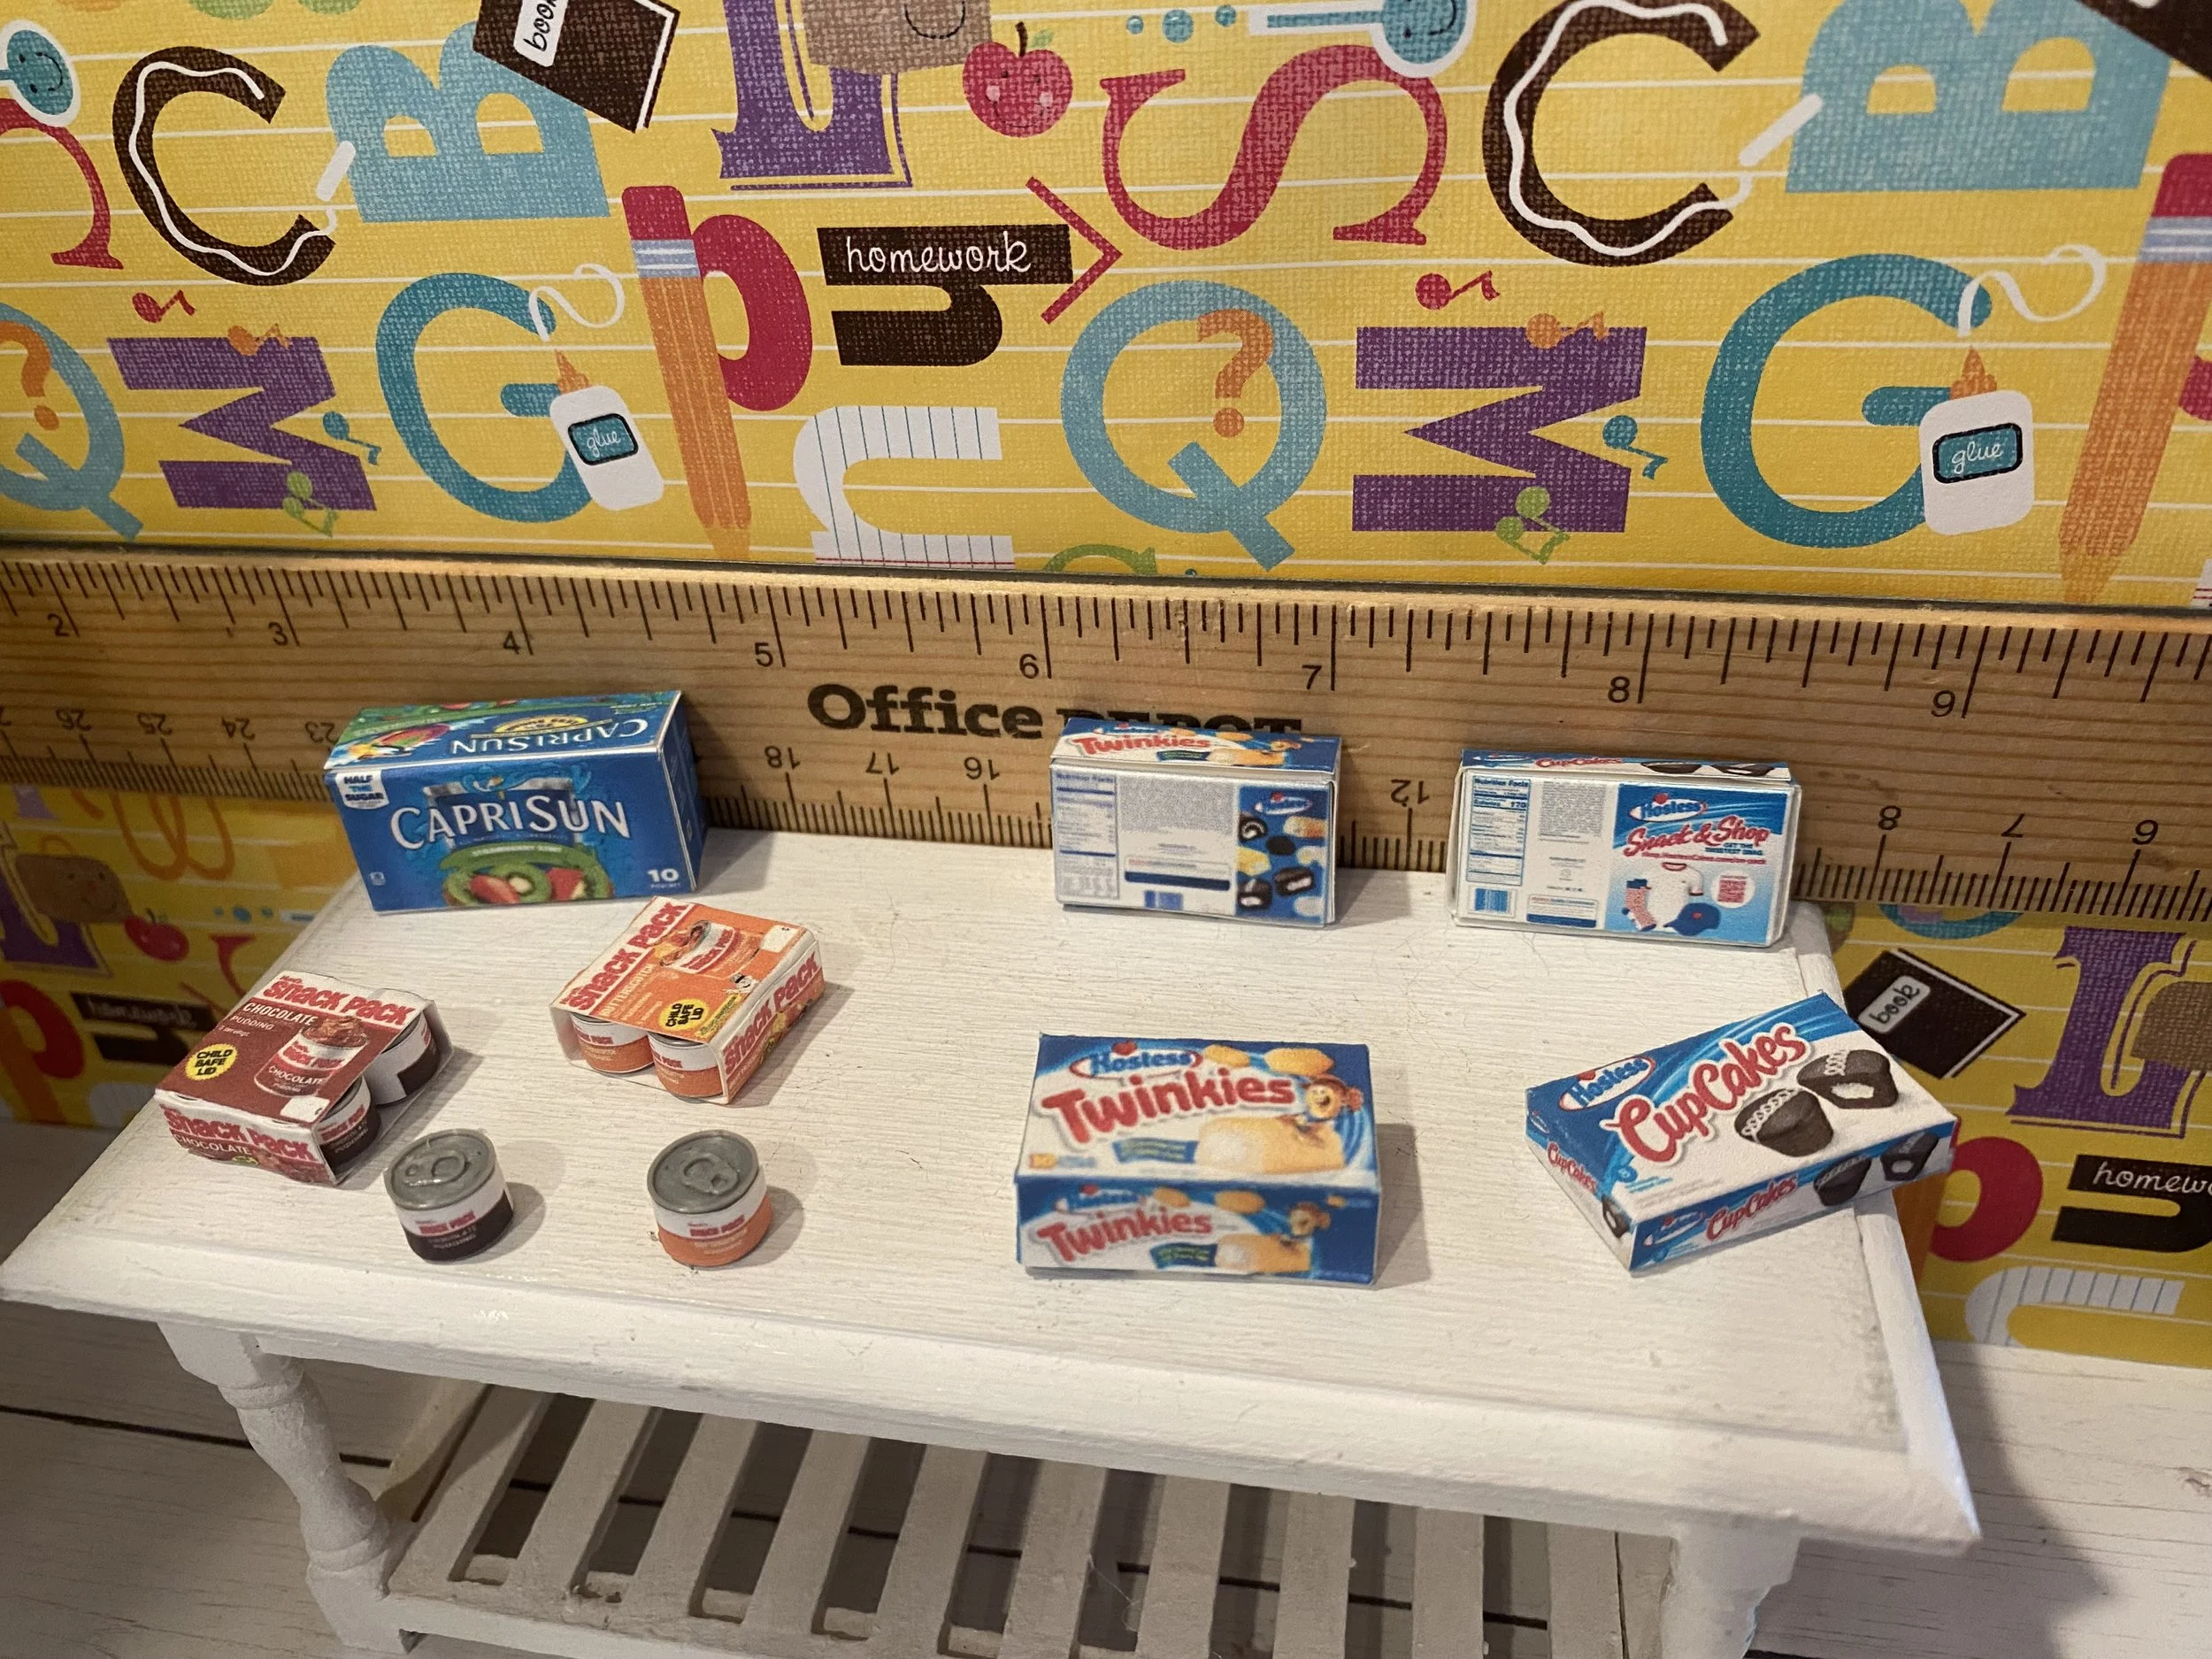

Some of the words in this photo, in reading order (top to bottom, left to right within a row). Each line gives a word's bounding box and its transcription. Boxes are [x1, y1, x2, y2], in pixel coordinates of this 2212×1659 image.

[1482, 0, 1760, 268] C
[112, 45, 336, 286] C
[846, 231, 1033, 274] homework
[587, 427, 621, 458] glue
[1951, 441, 2004, 474] glue
[48, 613, 70, 637] 2
[268, 622, 288, 647] 3
[503, 630, 521, 655] 4
[755, 641, 774, 668] 5
[1019, 654, 1040, 680] 6
[1302, 664, 1324, 690] 7
[1608, 676, 1631, 704] 8
[1931, 689, 1956, 718] 9
[807, 682, 1044, 740] Office
[452, 718, 649, 755] CAPRISUN
[1071, 733, 1212, 756] Twinkies
[764, 745, 801, 770] 18
[865, 751, 900, 776] 17
[964, 756, 1001, 781] 16
[343, 774, 373, 784] HALF
[1390, 778, 1431, 808] 12
[389, 795, 631, 850] CAPRISUN
[1878, 805, 1903, 832] 8
[1623, 824, 1694, 857] Snack
[1714, 815, 1770, 848] Shop
[647, 868, 680, 883] 10
[626, 902, 689, 953] Pack
[242, 1002, 319, 1027] CHOCOLATE
[342, 995, 417, 1026] Pack
[665, 1002, 684, 1027] CHILD
[678, 1003, 695, 1025] SAFE
[689, 1004, 705, 1021] LID
[1873, 984, 1922, 1025] book
[229, 1015, 276, 1031] PUDDING
[194, 1057, 227, 1069] SAFE
[196, 1049, 234, 1059] CHILD
[1088, 1048, 1192, 1077] Hostess
[196, 1067, 218, 1076] LID
[268, 1064, 324, 1085] CHOCOLATE
[1564, 1057, 1650, 1108] Hostess
[1041, 1066, 1296, 1144] Twinkies
[1603, 1025, 1808, 1164] CupCakes
[173, 1133, 251, 1156] CHOCOLATE
[2093, 1160, 2212, 1196] homew
[1705, 1174, 1798, 1241] CupCakes
[1036, 1205, 1213, 1263] Twinkies
